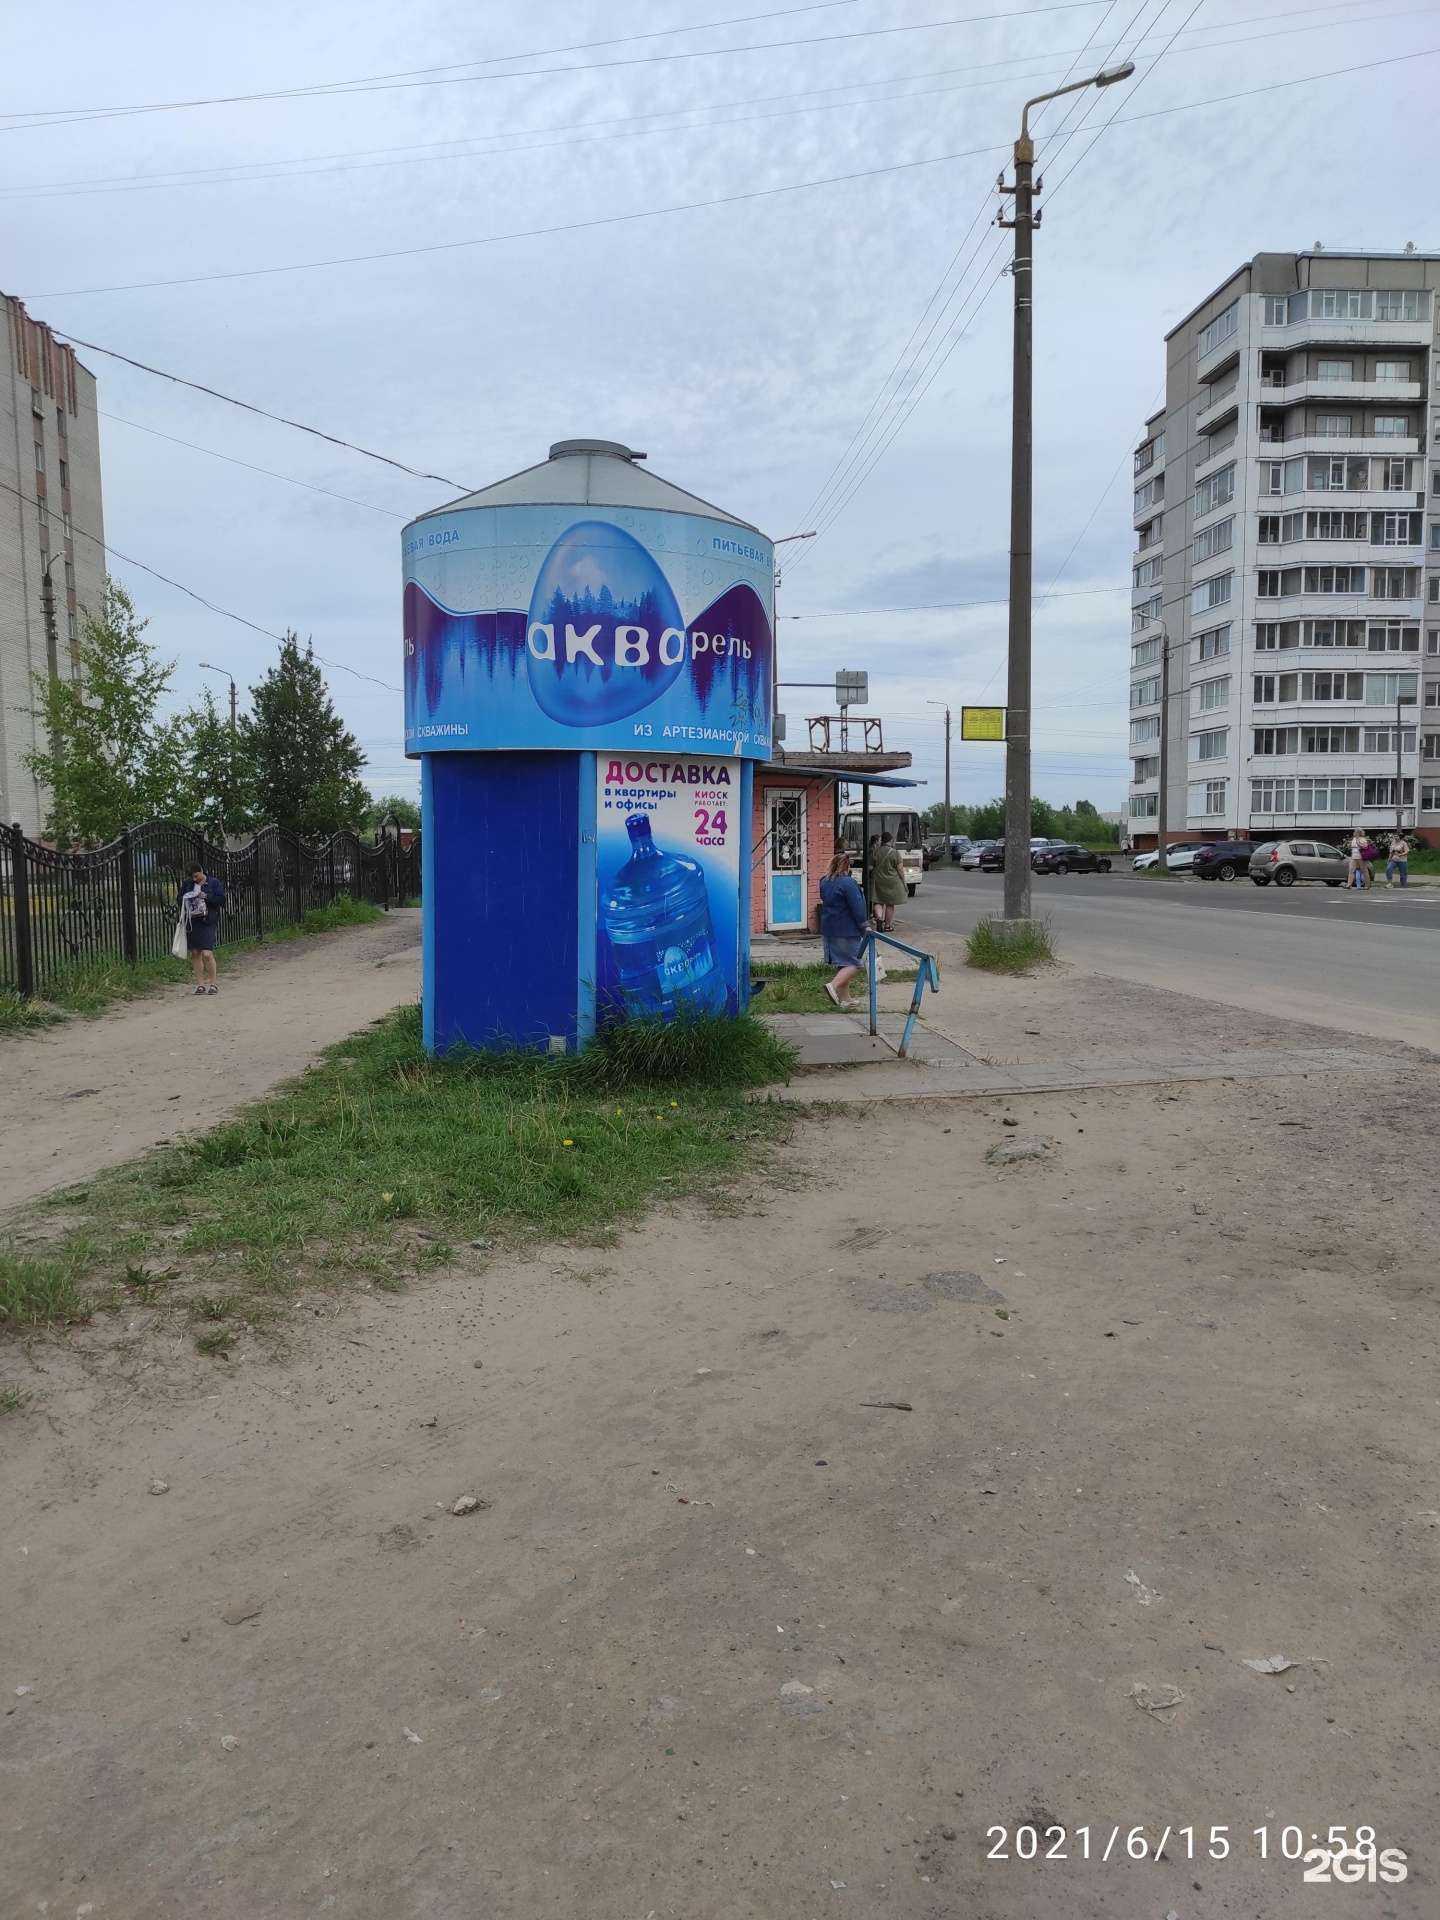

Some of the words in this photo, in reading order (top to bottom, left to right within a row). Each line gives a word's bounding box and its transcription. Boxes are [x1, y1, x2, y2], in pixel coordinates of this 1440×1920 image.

[429, 529, 460, 546] ВОДА
[712, 537, 764, 563] ПИТЬЕВАЯ
[417, 723, 469, 738] СКВАЖИНЫ
[634, 724, 653, 737] ИЗ
[662, 725, 750, 743] АРТЕЗИАНСКОЙ
[605, 760, 731, 785] ДОСТАВКА
[615, 788, 676, 800] квартиры
[695, 790, 729, 799] КИОСК
[616, 799, 657, 812] офисы
[694, 808, 728, 835] 24
[696, 836, 725, 846] часа
